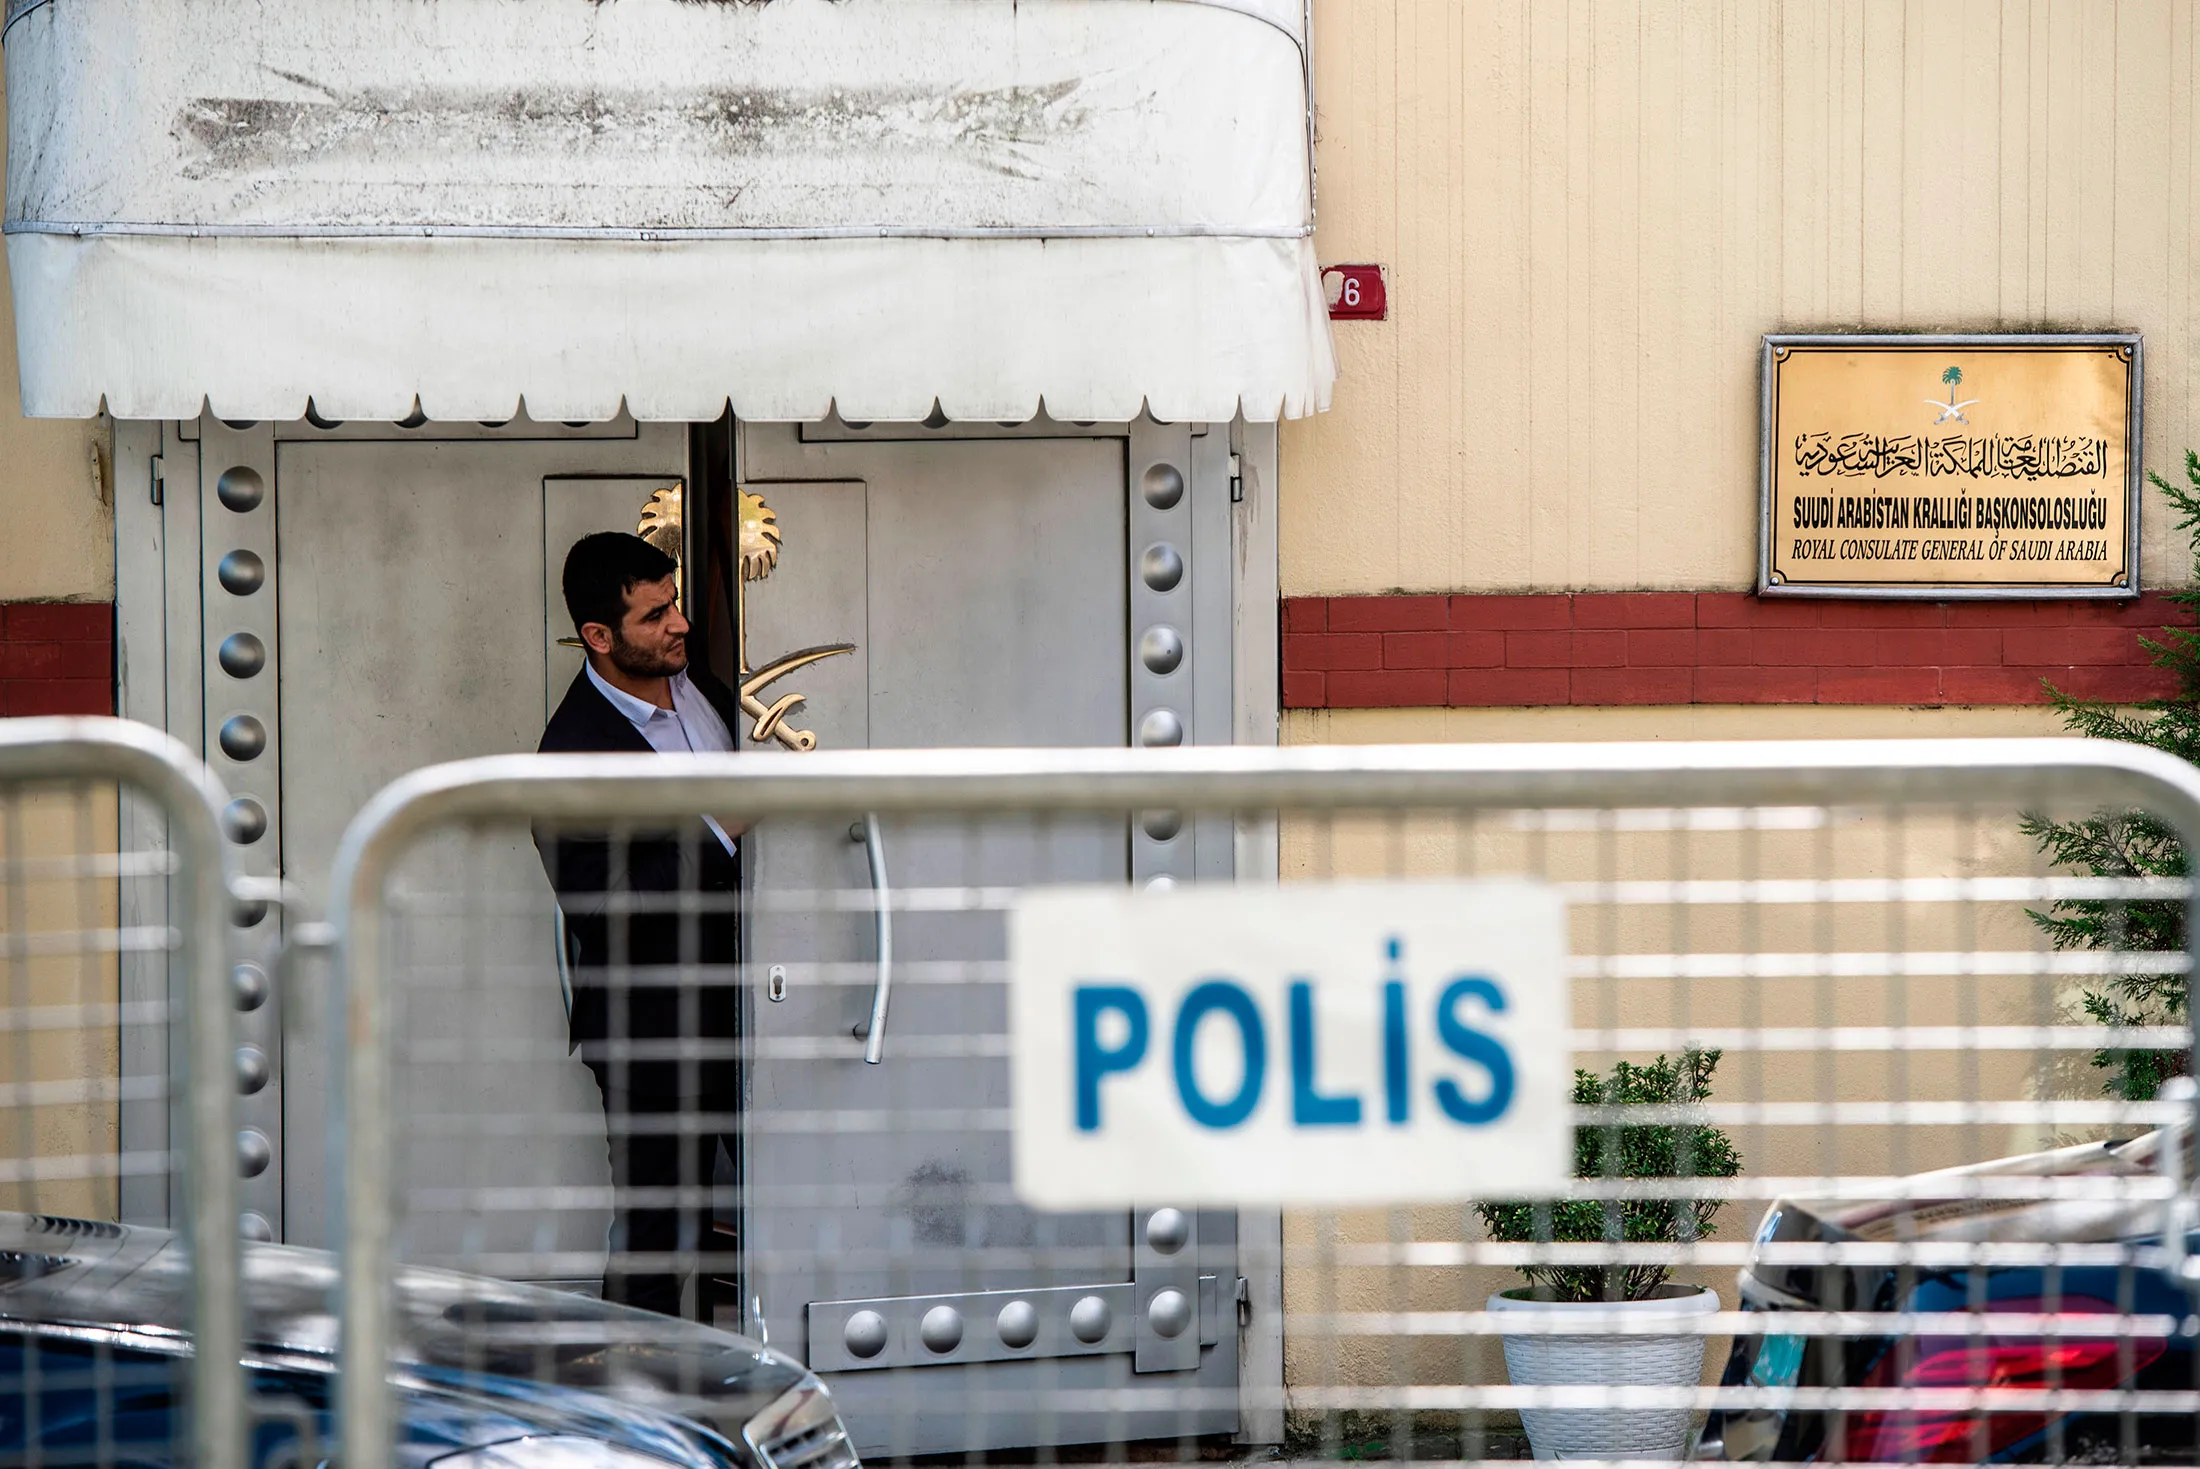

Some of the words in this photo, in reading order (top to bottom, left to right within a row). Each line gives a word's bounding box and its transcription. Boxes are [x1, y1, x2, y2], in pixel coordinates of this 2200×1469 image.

[1793, 487, 1834, 529] SUUDİ
[1837, 487, 1909, 529] ARABİSTAN
[1913, 487, 1972, 530] KRALLIĞI
[1976, 487, 2107, 539] BAŞKONSOLOSLUĞU
[1791, 539, 1837, 561] ROYAL
[1840, 539, 1919, 561] CONSULATE
[1921, 539, 1985, 561] GENERAL
[1988, 539, 2008, 561] OF
[2009, 539, 2054, 561] SAUDI
[2055, 539, 2107, 561] ARABIA
[1070, 932, 1519, 1134] POLİS
